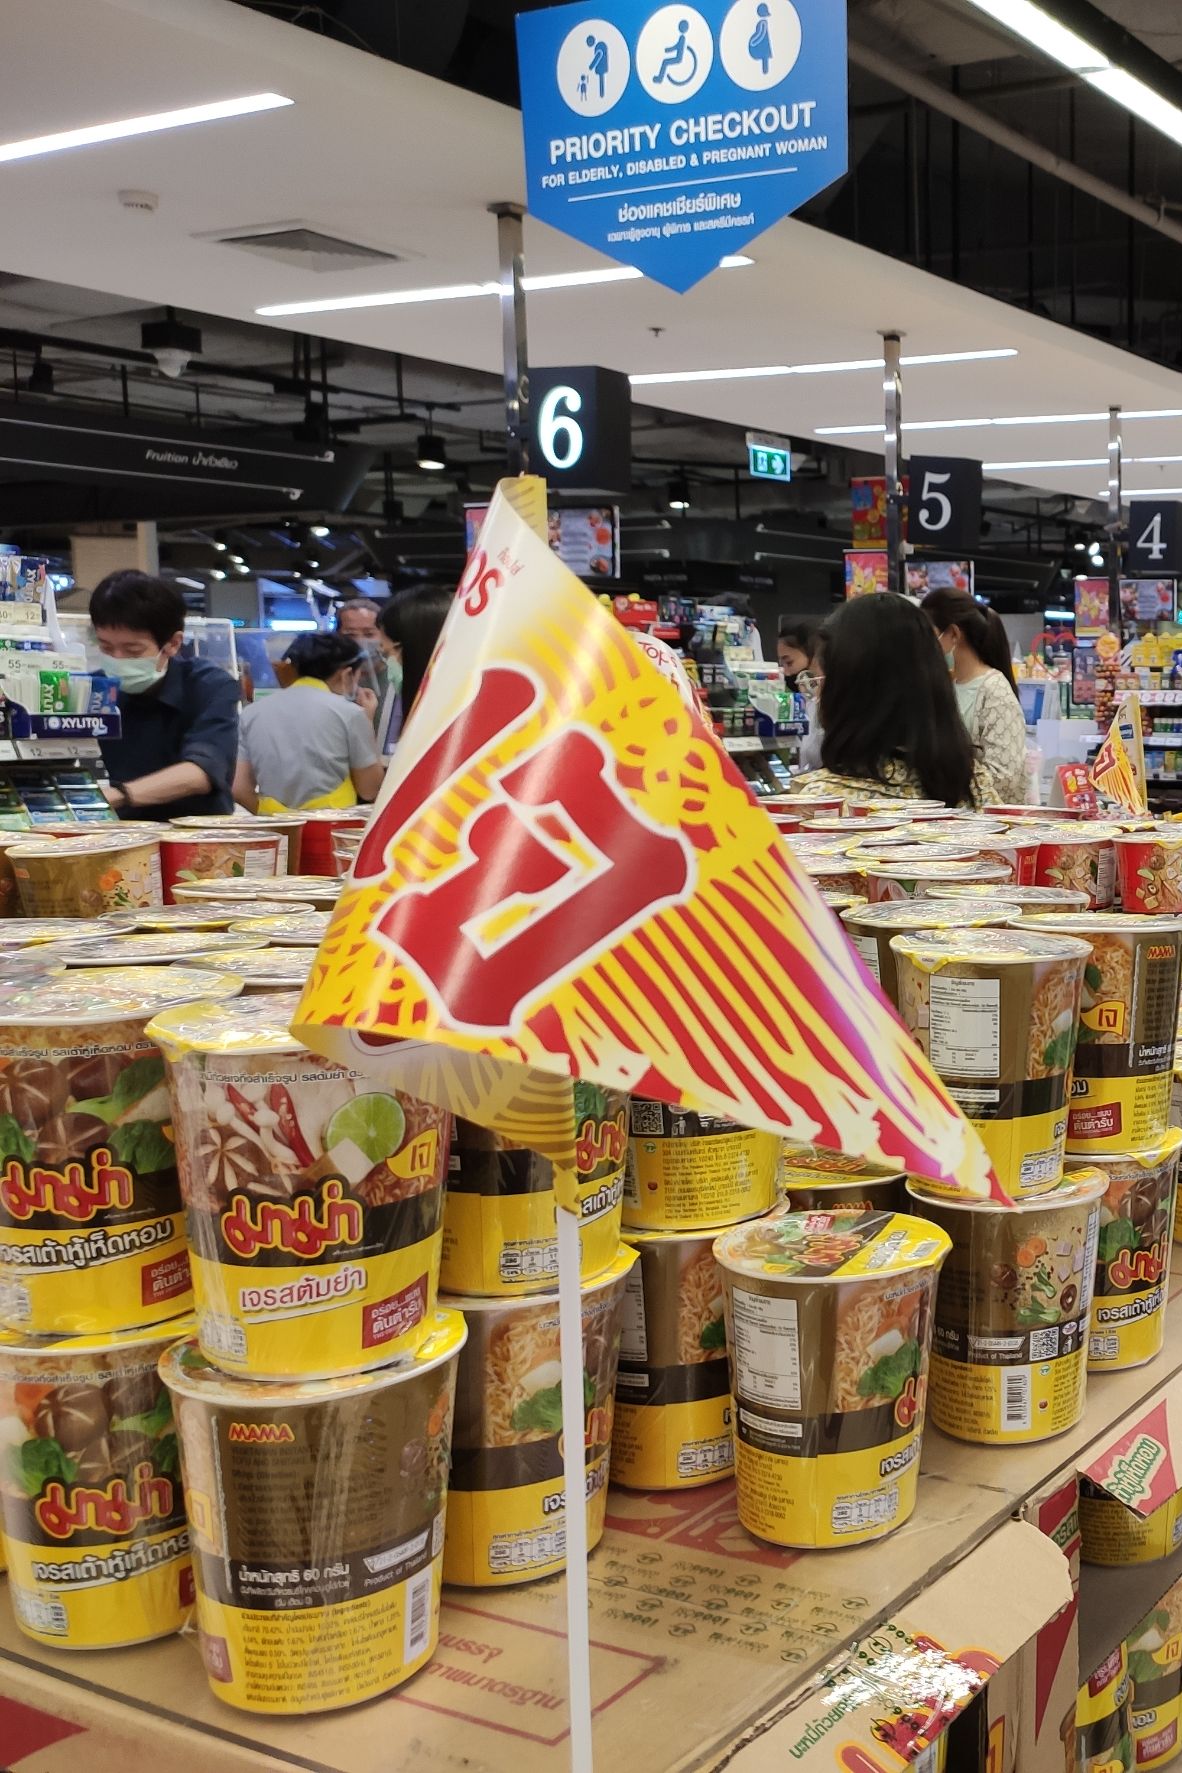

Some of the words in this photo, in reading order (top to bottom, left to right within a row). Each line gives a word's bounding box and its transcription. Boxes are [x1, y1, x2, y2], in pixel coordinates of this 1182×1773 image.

[550, 123, 661, 165] PRIORITY
[669, 101, 816, 146] CHECKOUT
[542, 173, 565, 189] FOR
[568, 164, 623, 185] ELDERLY,
[627, 155, 686, 176] DISABLED
[690, 153, 699, 167] &
[703, 143, 771, 165] PREGNANT
[776, 136, 828, 156] WOMAN
[537, 384, 583, 469] 6
[145, 449, 189, 464] Fruition
[918, 471, 952, 531] 5
[1136, 513, 1168, 560] 4
[61, 716, 105, 730] XYLITOL
[1098, 1008, 1118, 1028] เจ
[410, 1140, 432, 1171] เจ
[220, 1179, 365, 1259] มาม่า
[240, 1264, 367, 1312] เจรสต้มยำ
[229, 1422, 295, 1443] MAMA
[35, 1461, 174, 1539] มาม่า
[32, 1529, 191, 1582] เจรสเต้าหู้เห็ดหอ
[303, 1567, 321, 1582] 60
[364, 1571, 394, 1588] Product
[405, 1551, 427, 1571] Thailand
[440, 1633, 504, 1664] บรรจุ
[428, 1660, 565, 1711] ภาพมาตรฐาน
